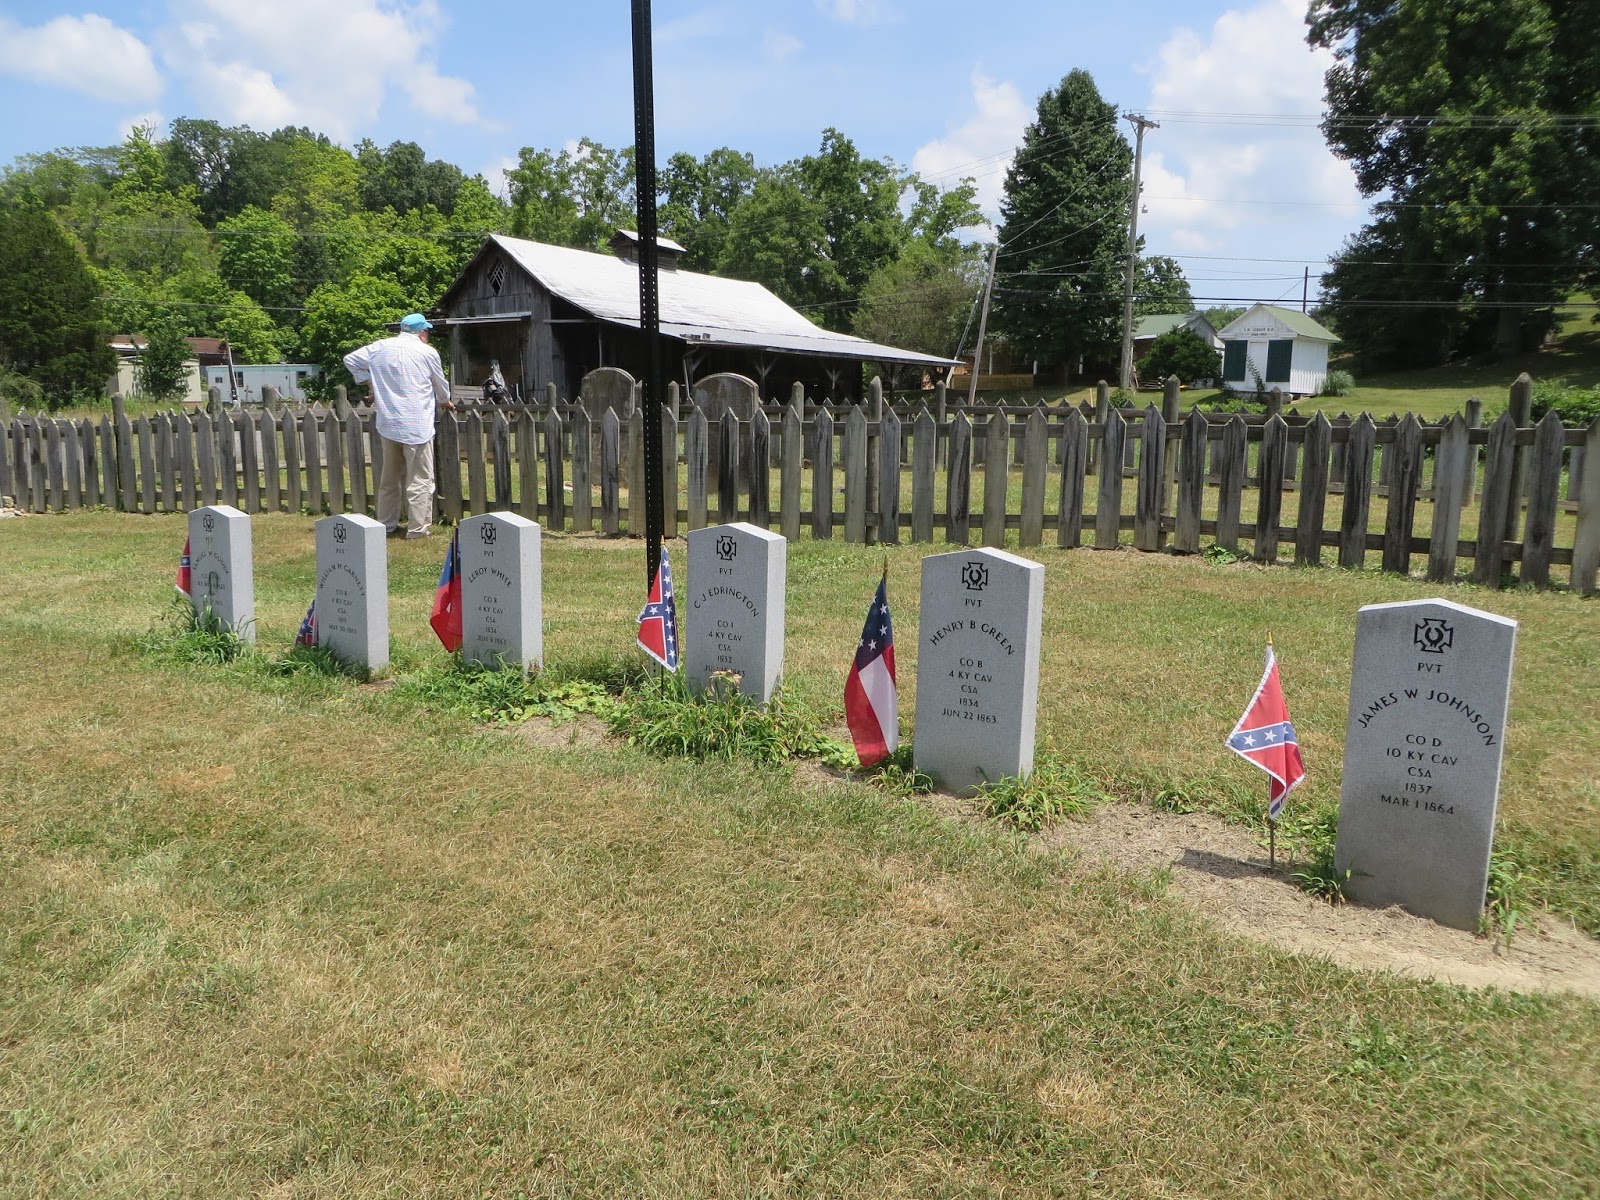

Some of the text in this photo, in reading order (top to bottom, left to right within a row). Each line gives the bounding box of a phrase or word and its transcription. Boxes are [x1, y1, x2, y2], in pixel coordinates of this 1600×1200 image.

[484, 550, 494, 558] PVT
[719, 567, 733, 576] PVT
[320, 563, 336, 589] WILLIAM
[343, 564, 365, 596] GARNETT
[468, 567, 513, 588] LEROY WHITE
[483, 595, 493, 603] CO
[694, 586, 760, 618] C J EDRINGTON
[965, 599, 982, 608] PVT
[492, 607, 504, 615] CAV
[485, 616, 496, 624] CSA
[717, 619, 728, 628] CO
[715, 631, 725, 639] KY
[728, 633, 742, 642] CAV
[930, 620, 1015, 656] HENRY B GREEN
[718, 644, 732, 652] CSA
[717, 655, 733, 664] 1832
[960, 657, 983, 668] CO B
[1417, 662, 1444, 674] PVT
[949, 670, 993, 683] 4 KY CAV
[961, 684, 978, 694] CSA
[960, 698, 979, 708] 1834
[942, 708, 997, 724] JUN 22 1863
[1357, 688, 1497, 746] JAMES W JOHNSON
[1406, 734, 1442, 747] CO D
[1386, 747, 1458, 766] 10 KY CAV
[1408, 766, 1432, 779] CSA
[1405, 782, 1432, 794] 1837
[1381, 794, 1454, 815] MAR 1 1864
